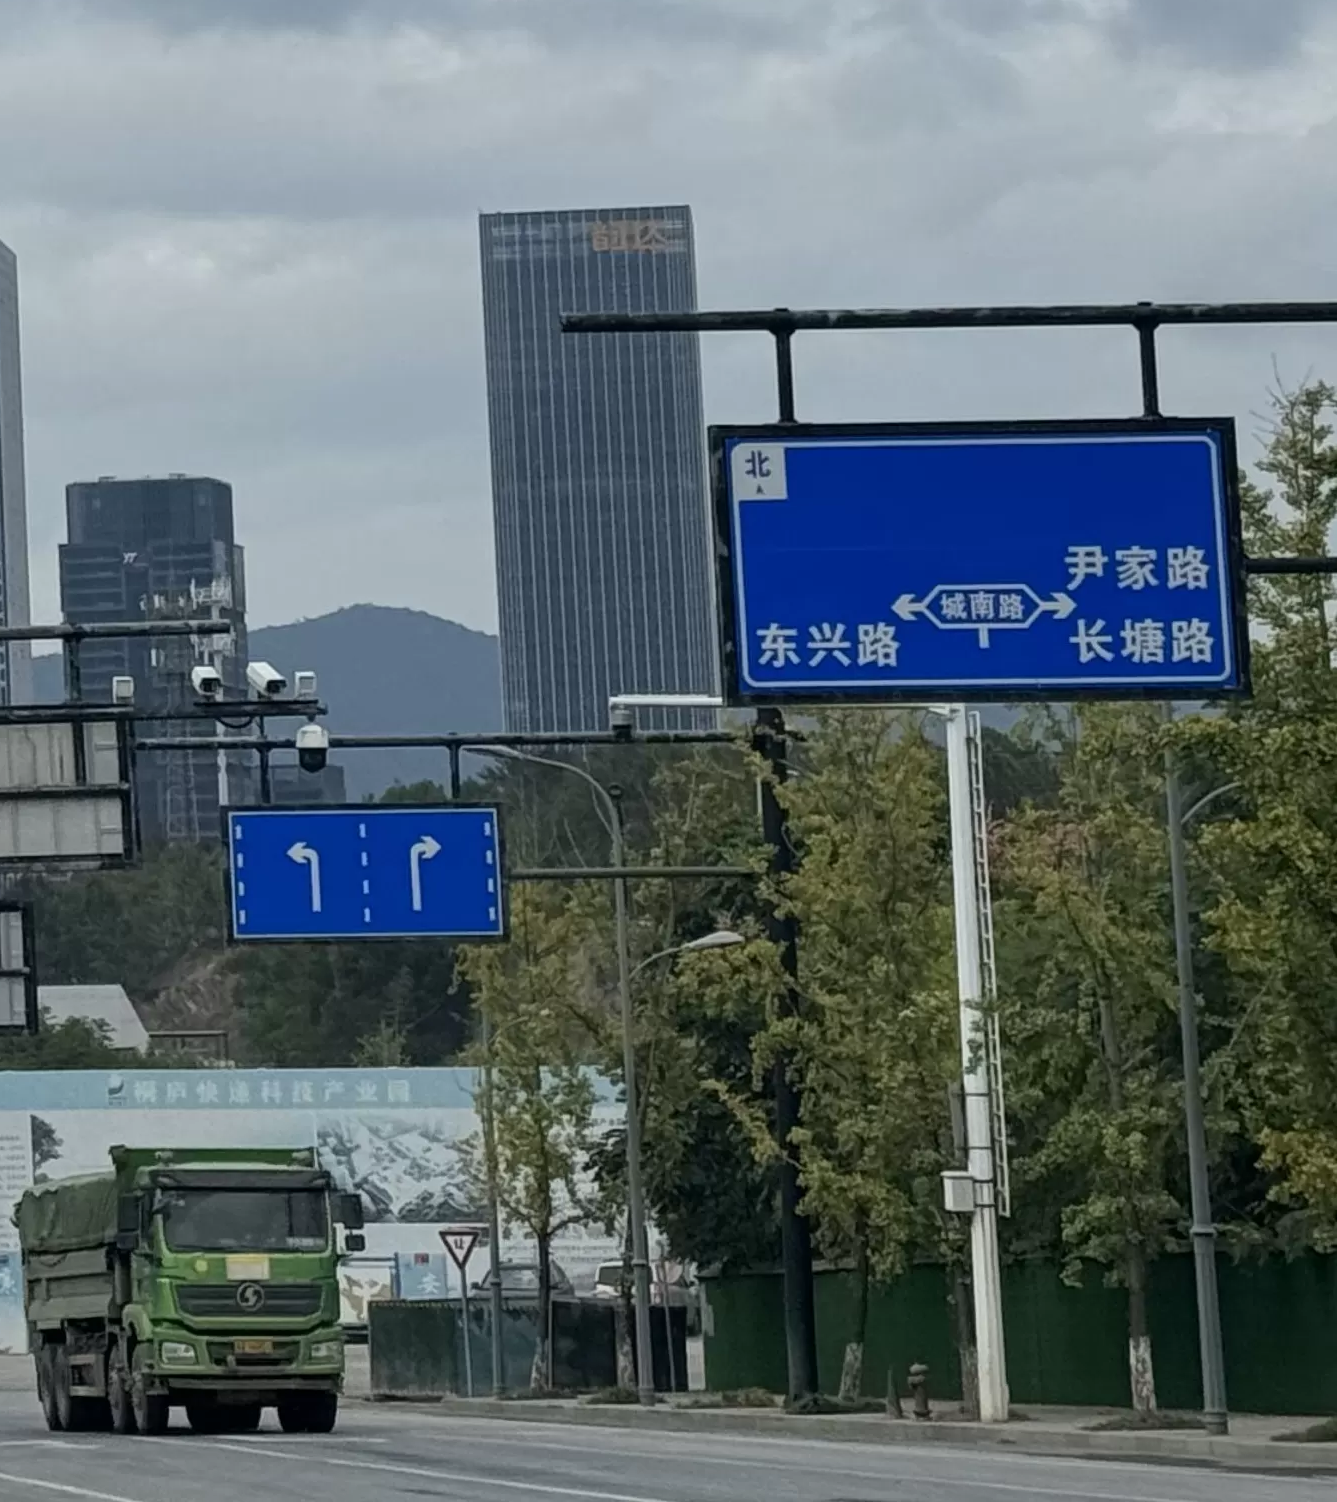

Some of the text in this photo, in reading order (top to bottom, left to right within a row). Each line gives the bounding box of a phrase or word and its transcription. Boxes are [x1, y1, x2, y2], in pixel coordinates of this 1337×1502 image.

[744, 450, 772, 480] 北
[1064, 546, 1210, 590] 尹家路
[940, 591, 1025, 620] 城南路
[756, 623, 901, 668] 东兴路
[1069, 618, 1215, 664] 长塘路
